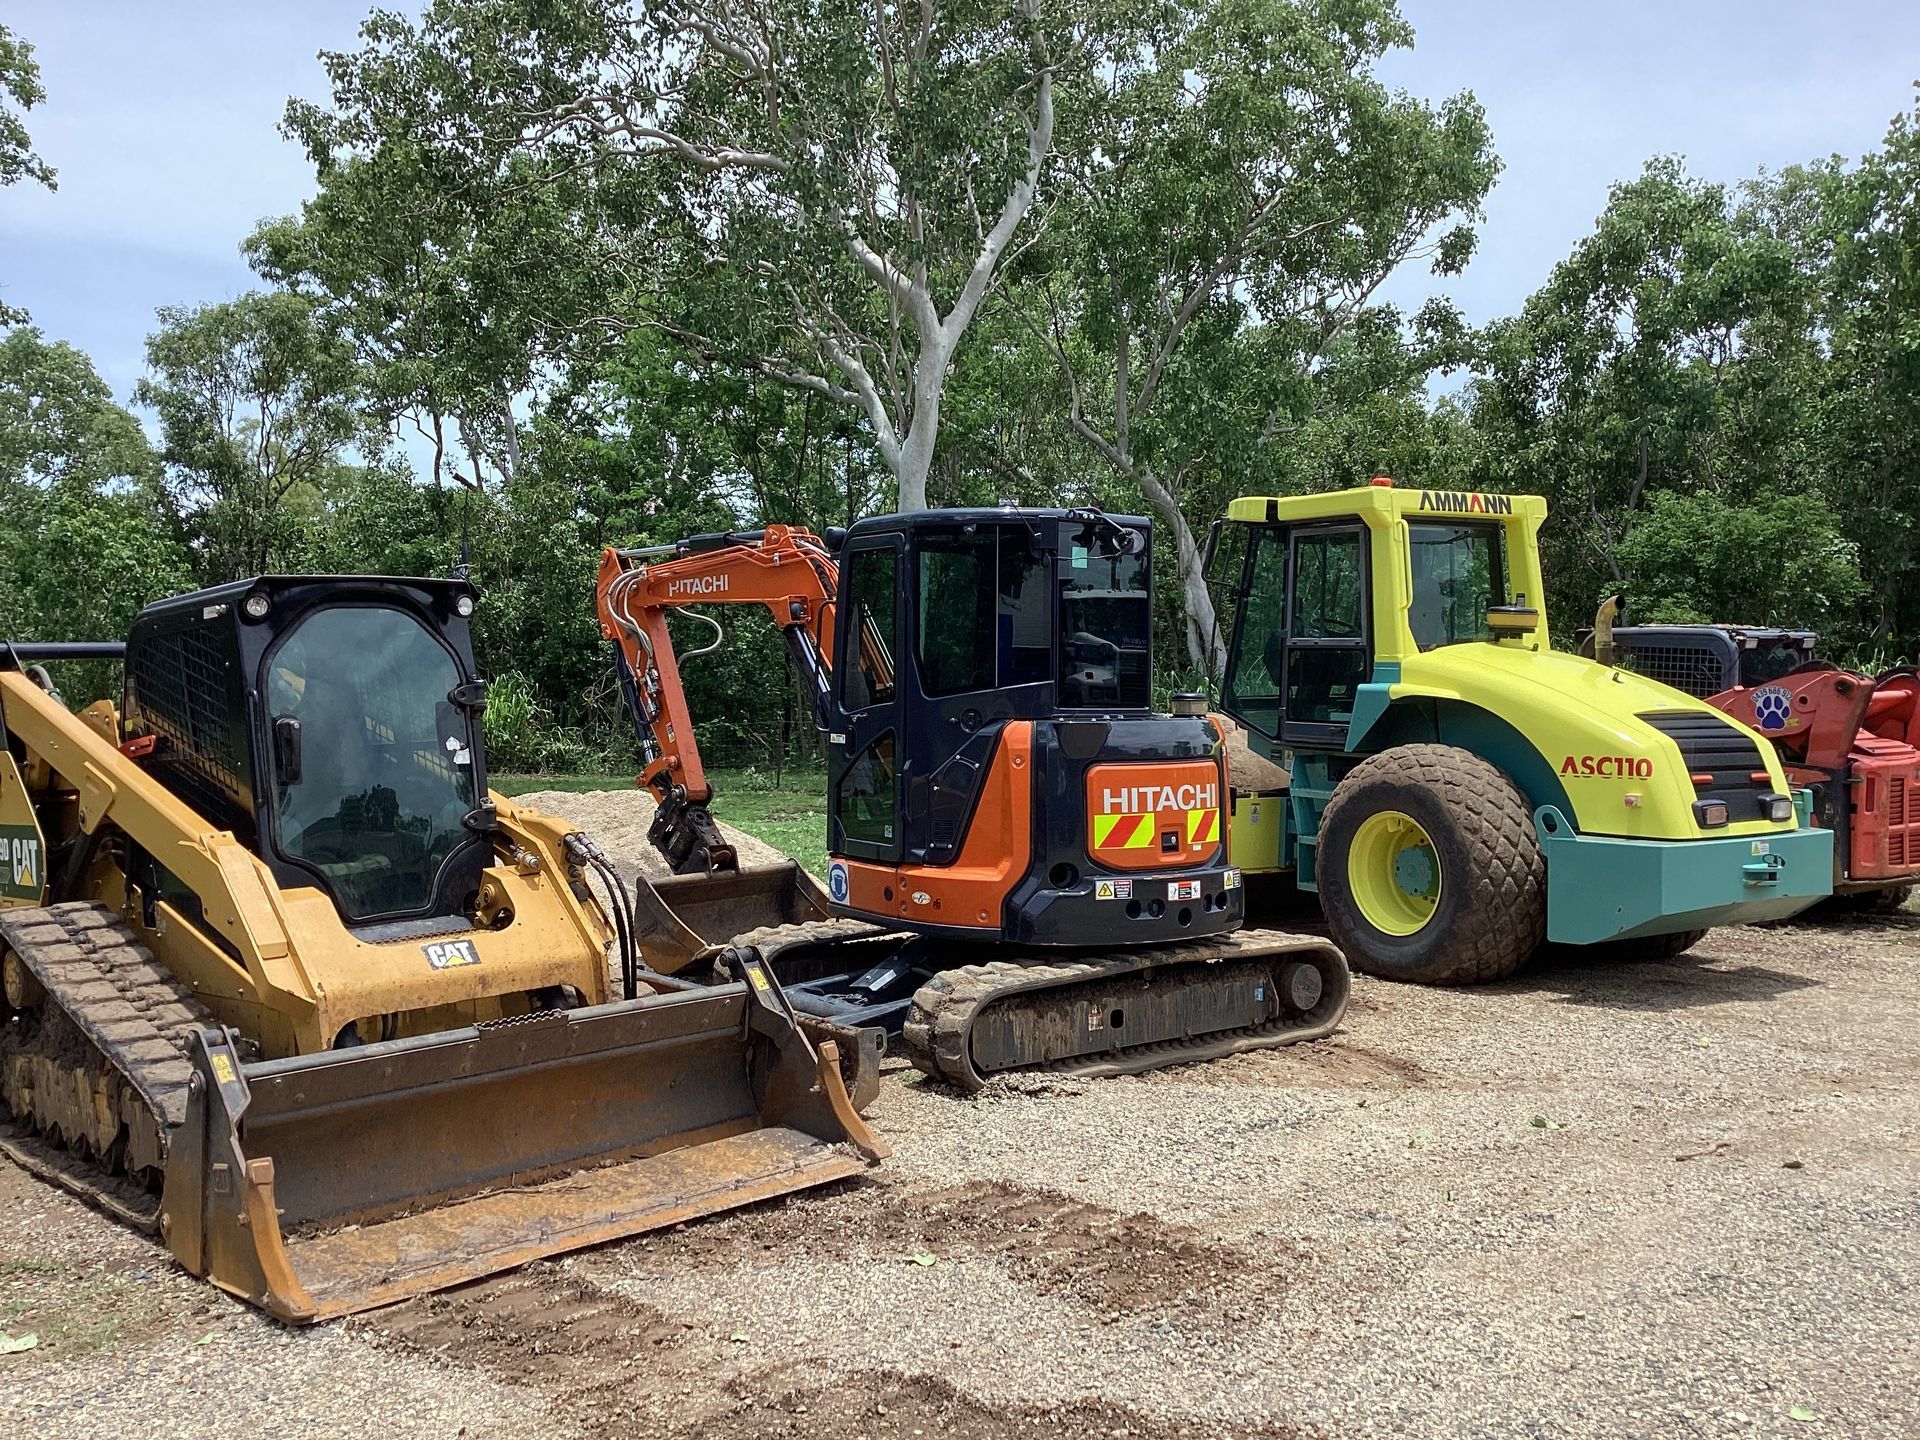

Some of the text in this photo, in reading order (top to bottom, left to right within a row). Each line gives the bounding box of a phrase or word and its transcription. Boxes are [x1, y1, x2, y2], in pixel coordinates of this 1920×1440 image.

[1419, 491, 1513, 514] AMMANN
[668, 574, 729, 597] HITACHI
[1751, 687, 1793, 703] 0439 686 912
[1559, 755, 1653, 780] ASC110
[1103, 783, 1216, 814] HITACHI
[12, 838, 37, 886] CAT
[427, 941, 473, 968] CAT
